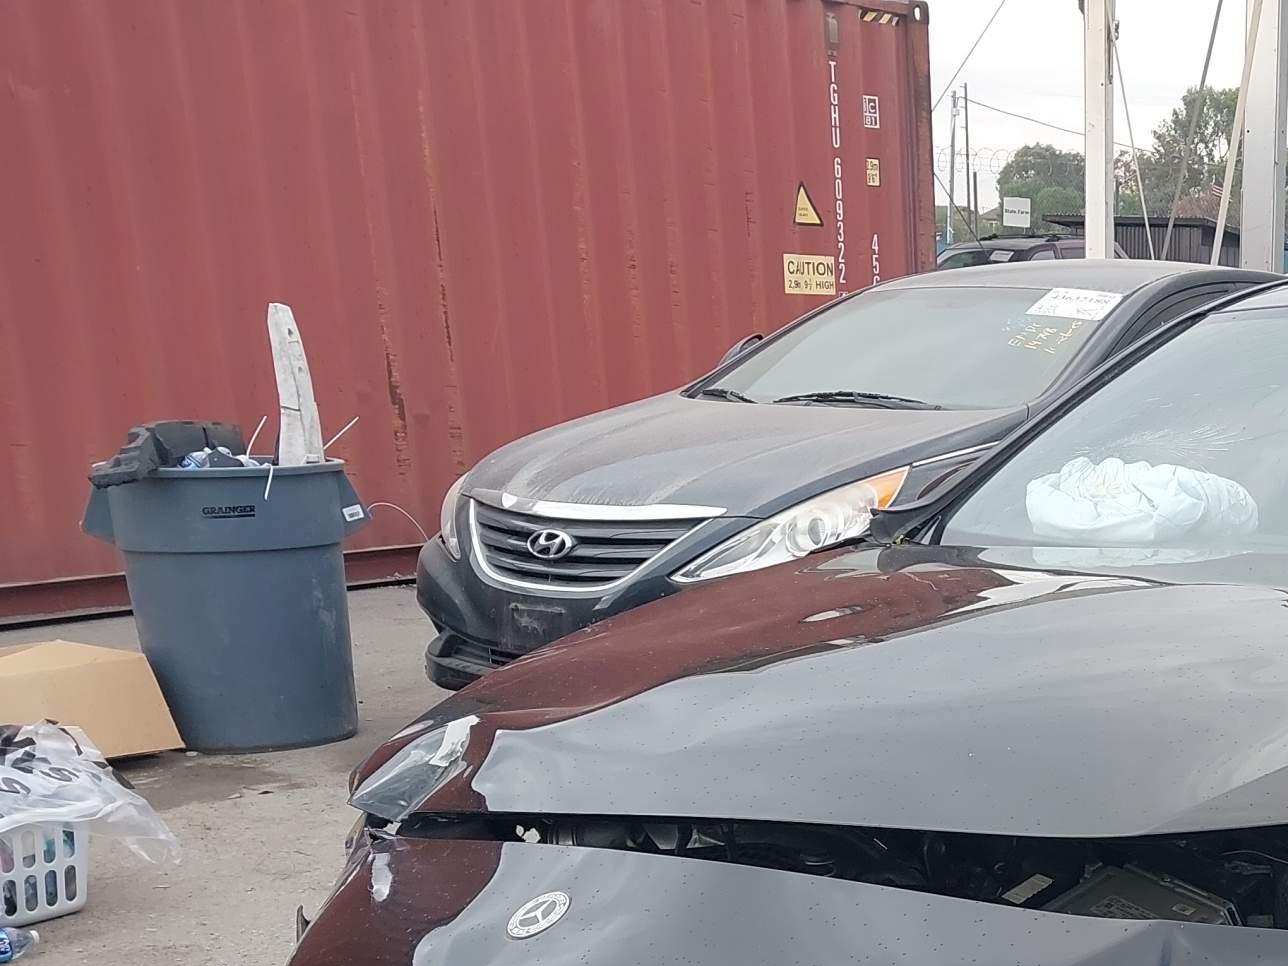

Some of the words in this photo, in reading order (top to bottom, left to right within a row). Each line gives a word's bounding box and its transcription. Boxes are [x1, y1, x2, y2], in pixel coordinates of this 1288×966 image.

[829, 61, 840, 148] TGHU
[834, 158, 847, 283] 609322
[787, 260, 834, 276] CAUTION
[815, 280, 834, 290] HIGH
[202, 505, 256, 516] GRAINGER
